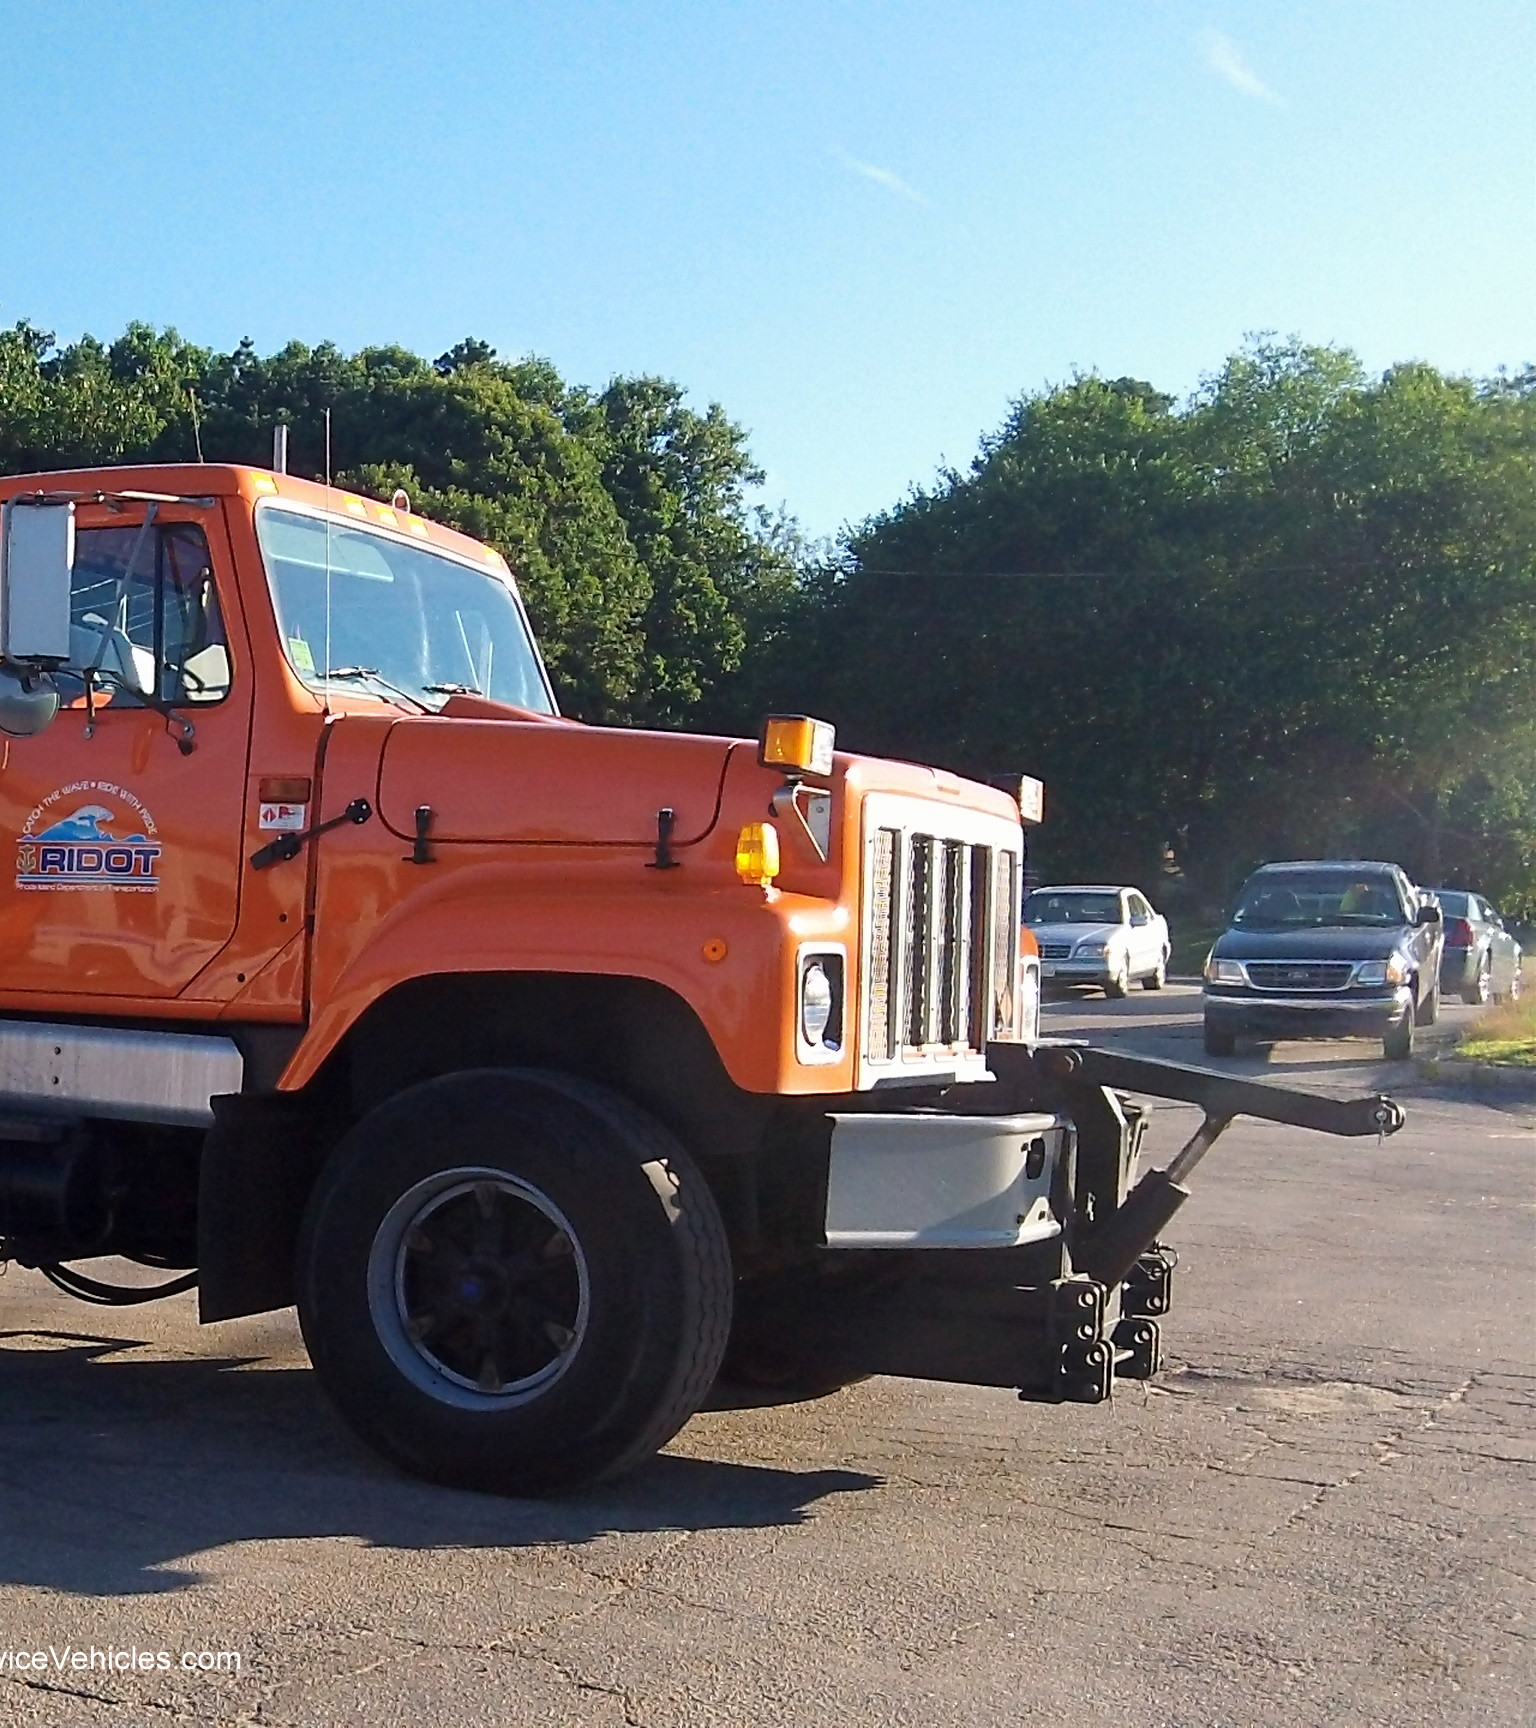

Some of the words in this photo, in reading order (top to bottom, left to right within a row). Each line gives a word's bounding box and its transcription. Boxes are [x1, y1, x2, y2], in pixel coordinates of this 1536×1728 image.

[43, 790, 61, 806] THE
[62, 781, 89, 795] WAVE
[97, 781, 119, 795] RIDE
[120, 789, 142, 810] WITH
[139, 808, 158, 834] PRIDE
[39, 846, 162, 875] RIDOT
